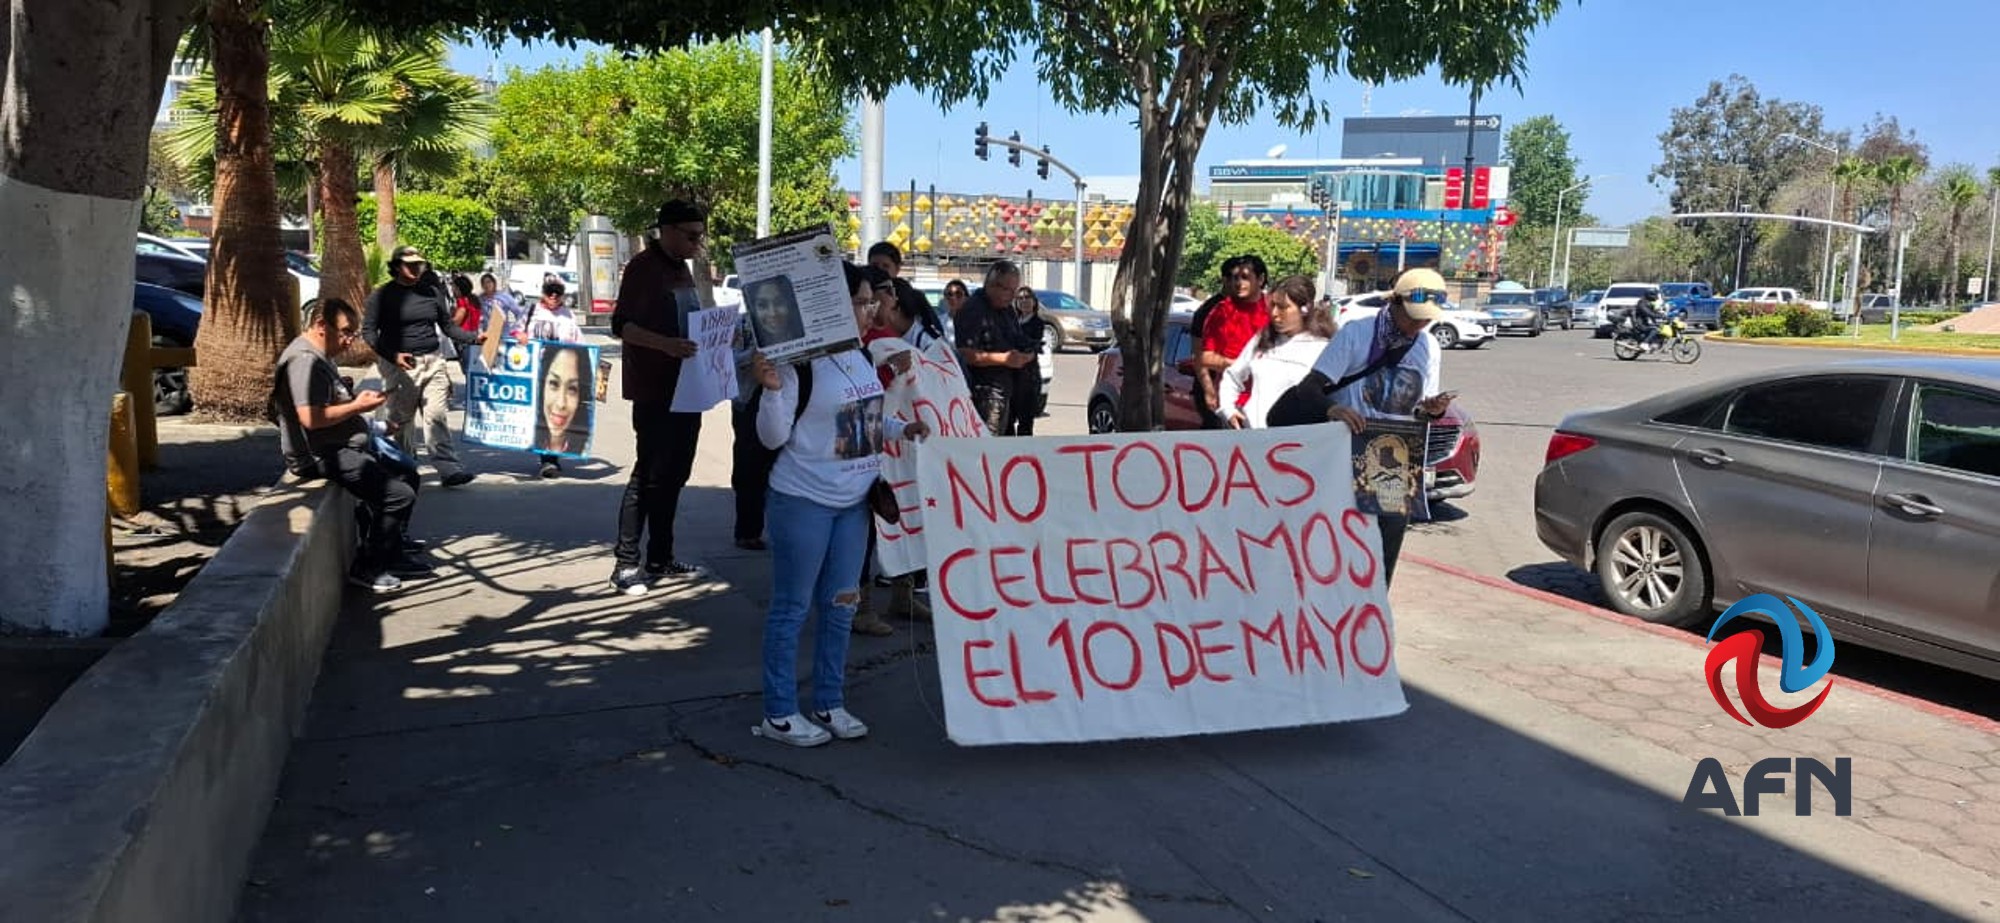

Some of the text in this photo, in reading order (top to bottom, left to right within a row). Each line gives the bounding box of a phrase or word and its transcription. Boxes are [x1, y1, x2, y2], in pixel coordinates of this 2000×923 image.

[1213, 168, 1249, 176] BBVA
[473, 376, 528, 401] FLOR
[947, 441, 1316, 530] NO TODAS
[938, 508, 1377, 621] CELEBRAMOS
[963, 603, 1391, 707] EL 10 DE MAYO
